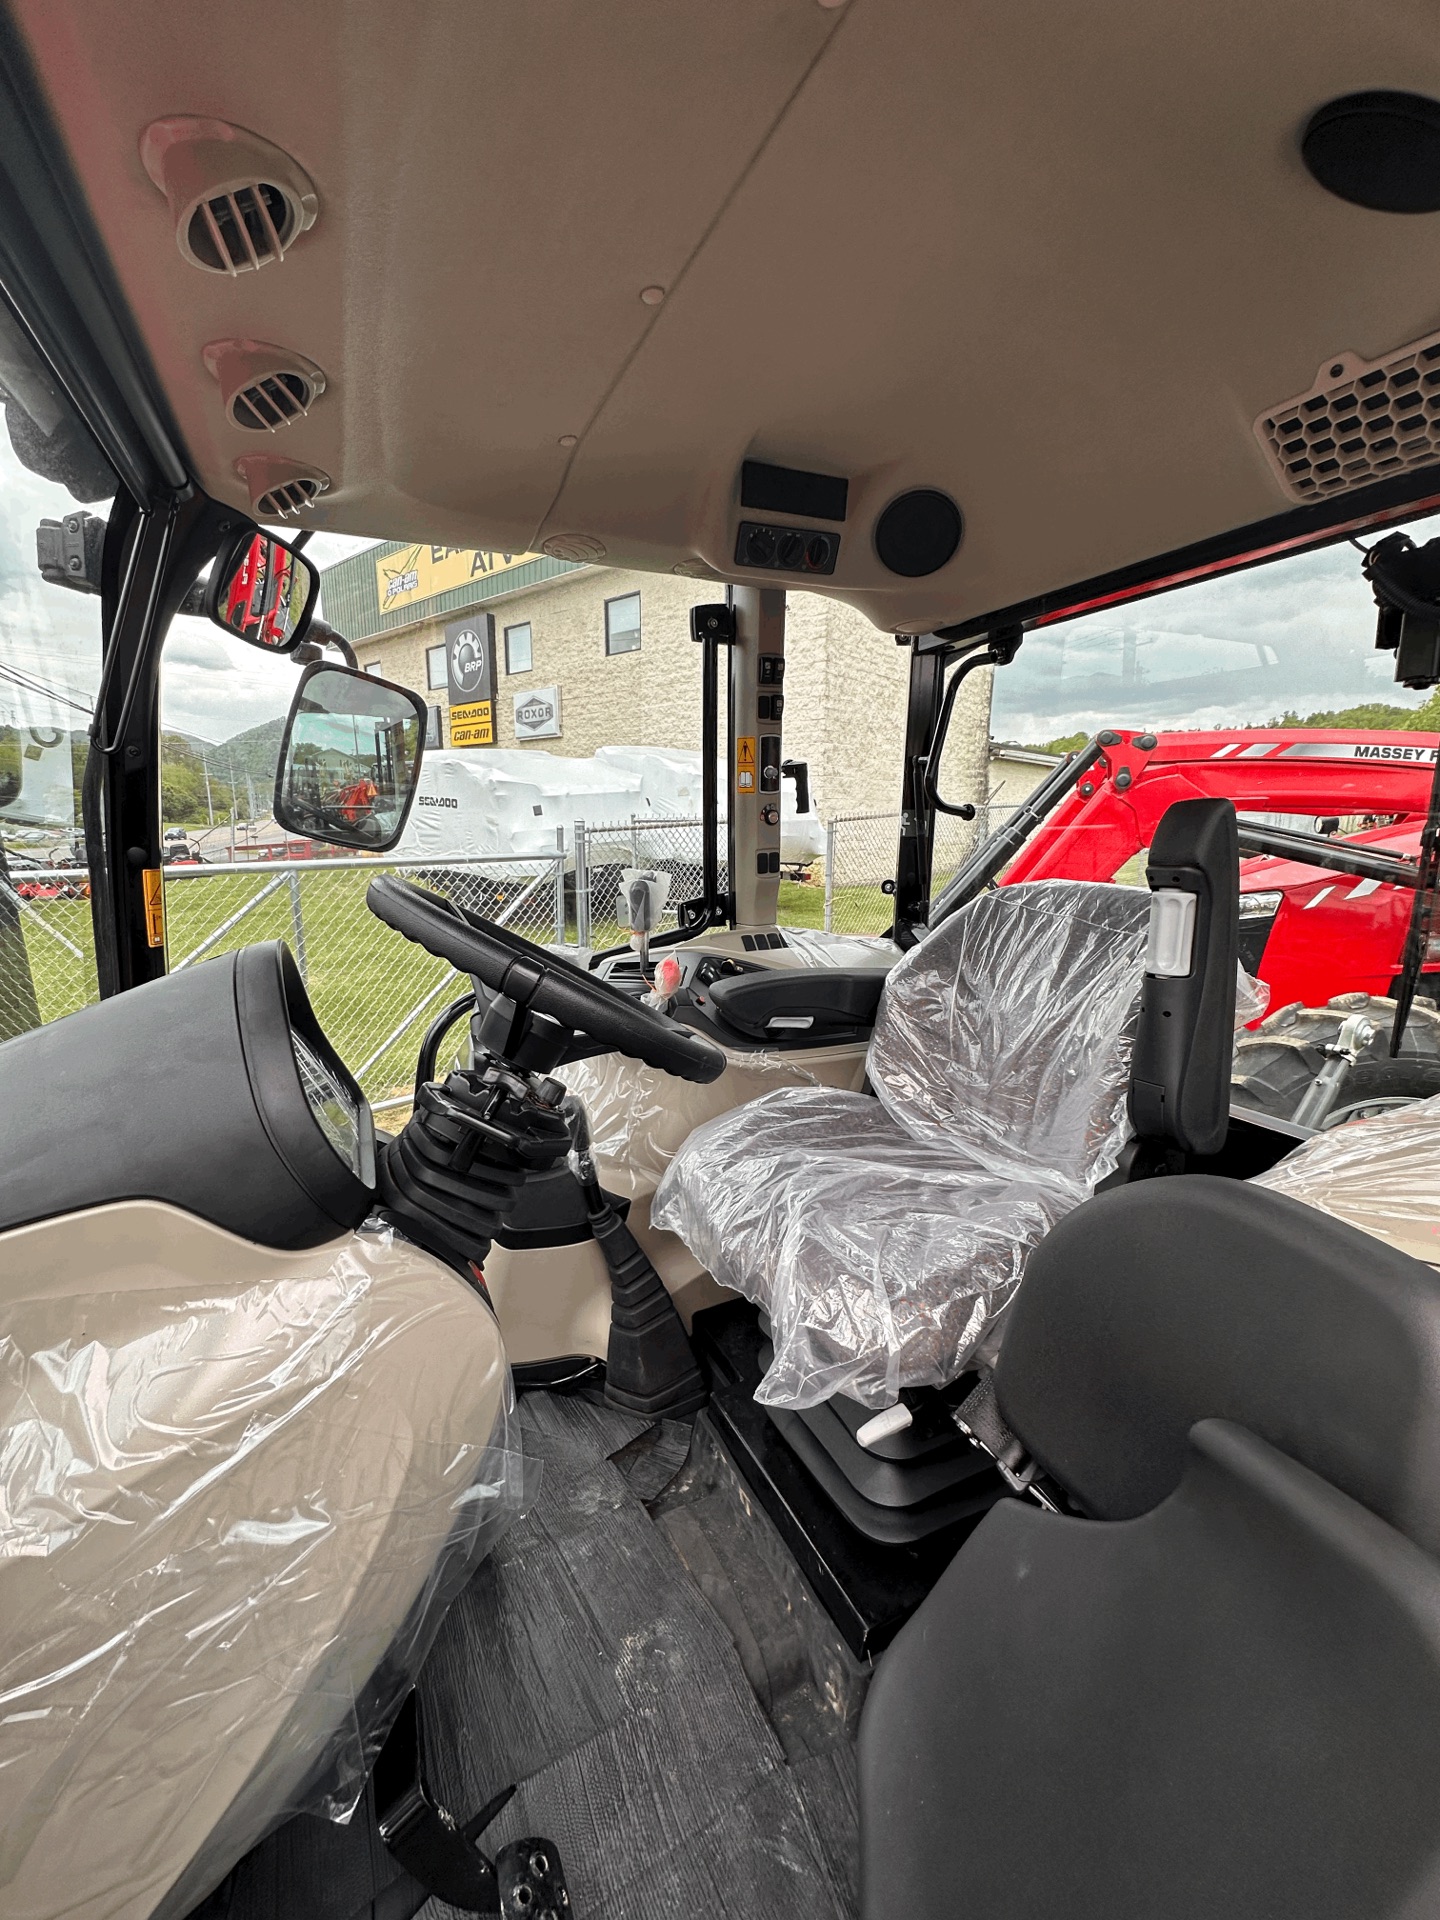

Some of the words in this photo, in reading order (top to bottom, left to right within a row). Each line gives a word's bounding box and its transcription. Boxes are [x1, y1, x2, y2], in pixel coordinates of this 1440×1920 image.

[464, 660, 482, 673] BRP
[517, 706, 552, 720] ROXOR
[1354, 746, 1425, 761] MASSEY
